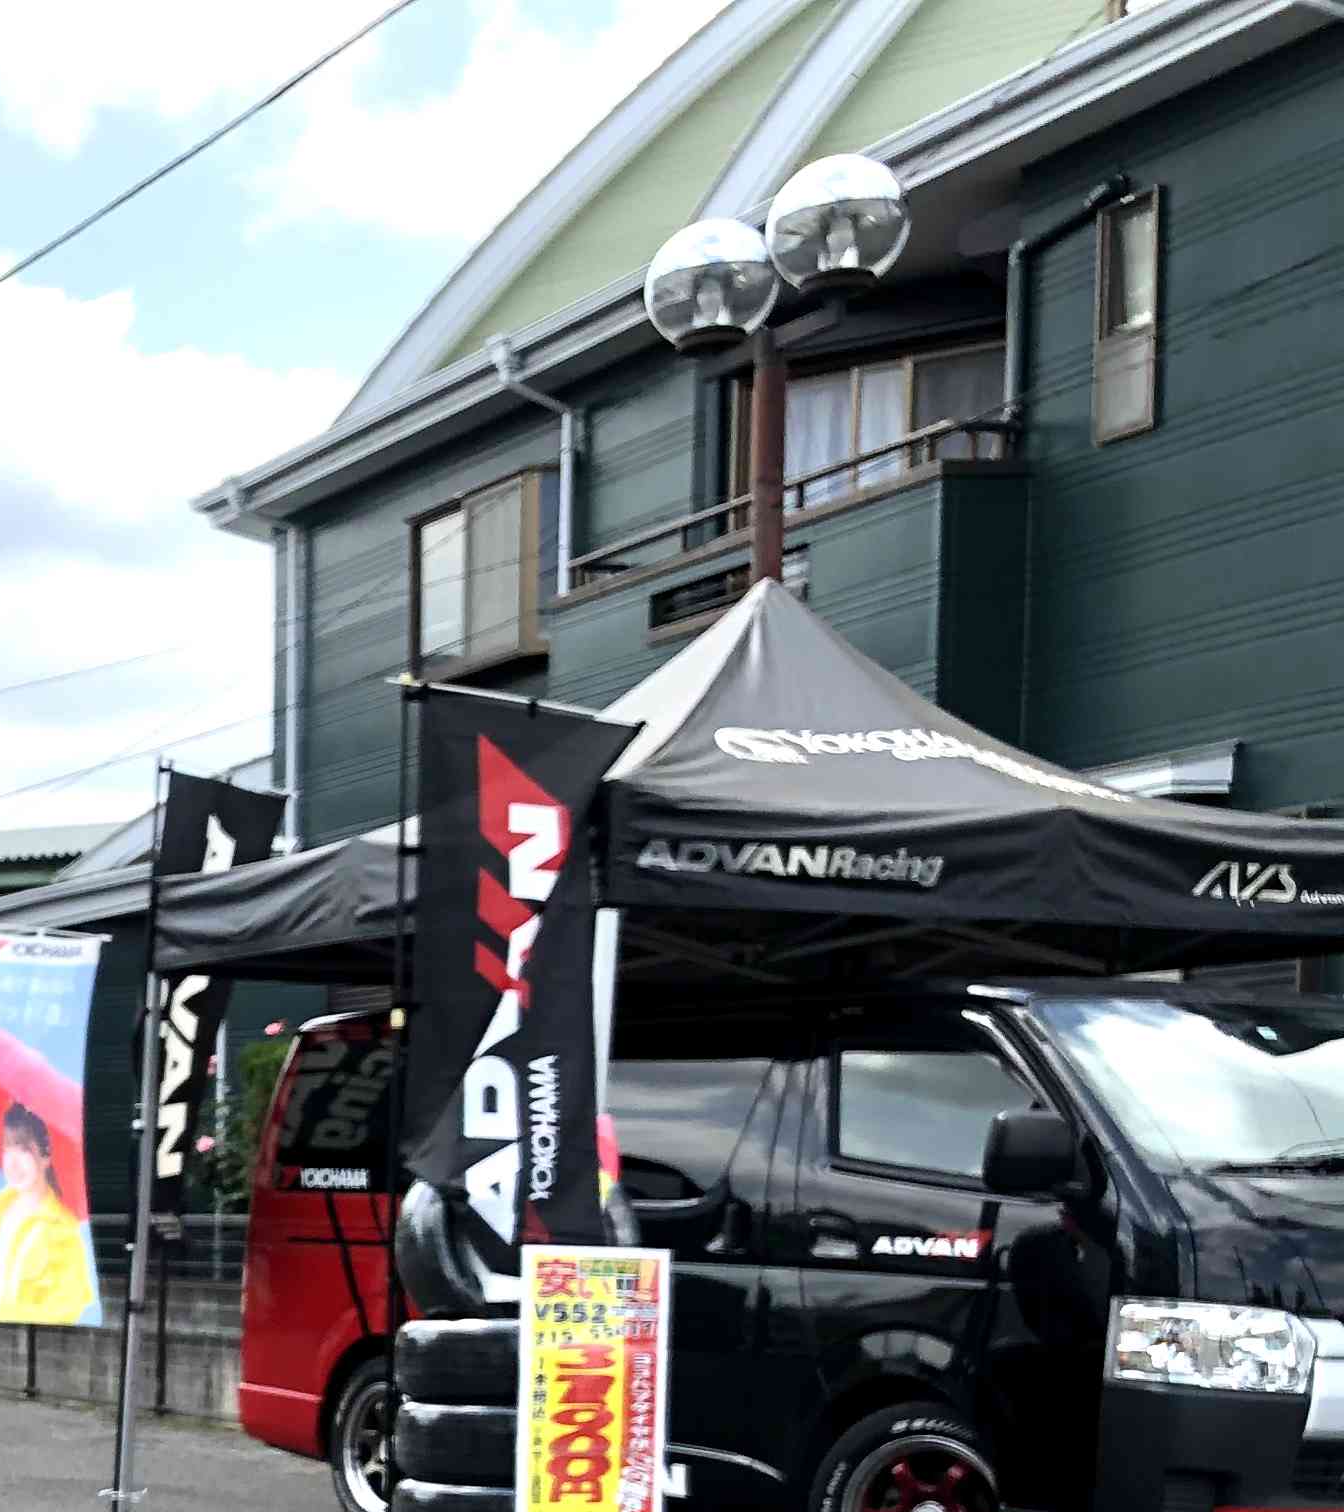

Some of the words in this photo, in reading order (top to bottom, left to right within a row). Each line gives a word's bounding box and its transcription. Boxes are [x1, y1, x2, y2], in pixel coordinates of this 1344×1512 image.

[158, 812, 237, 1180] AVAN
[527, 1054, 561, 1201] YOKOHAMA
[300, 1167, 370, 1189] YOKOHAMA
[871, 1235, 979, 1259] ADVAN
[534, 1302, 608, 1324] V552
